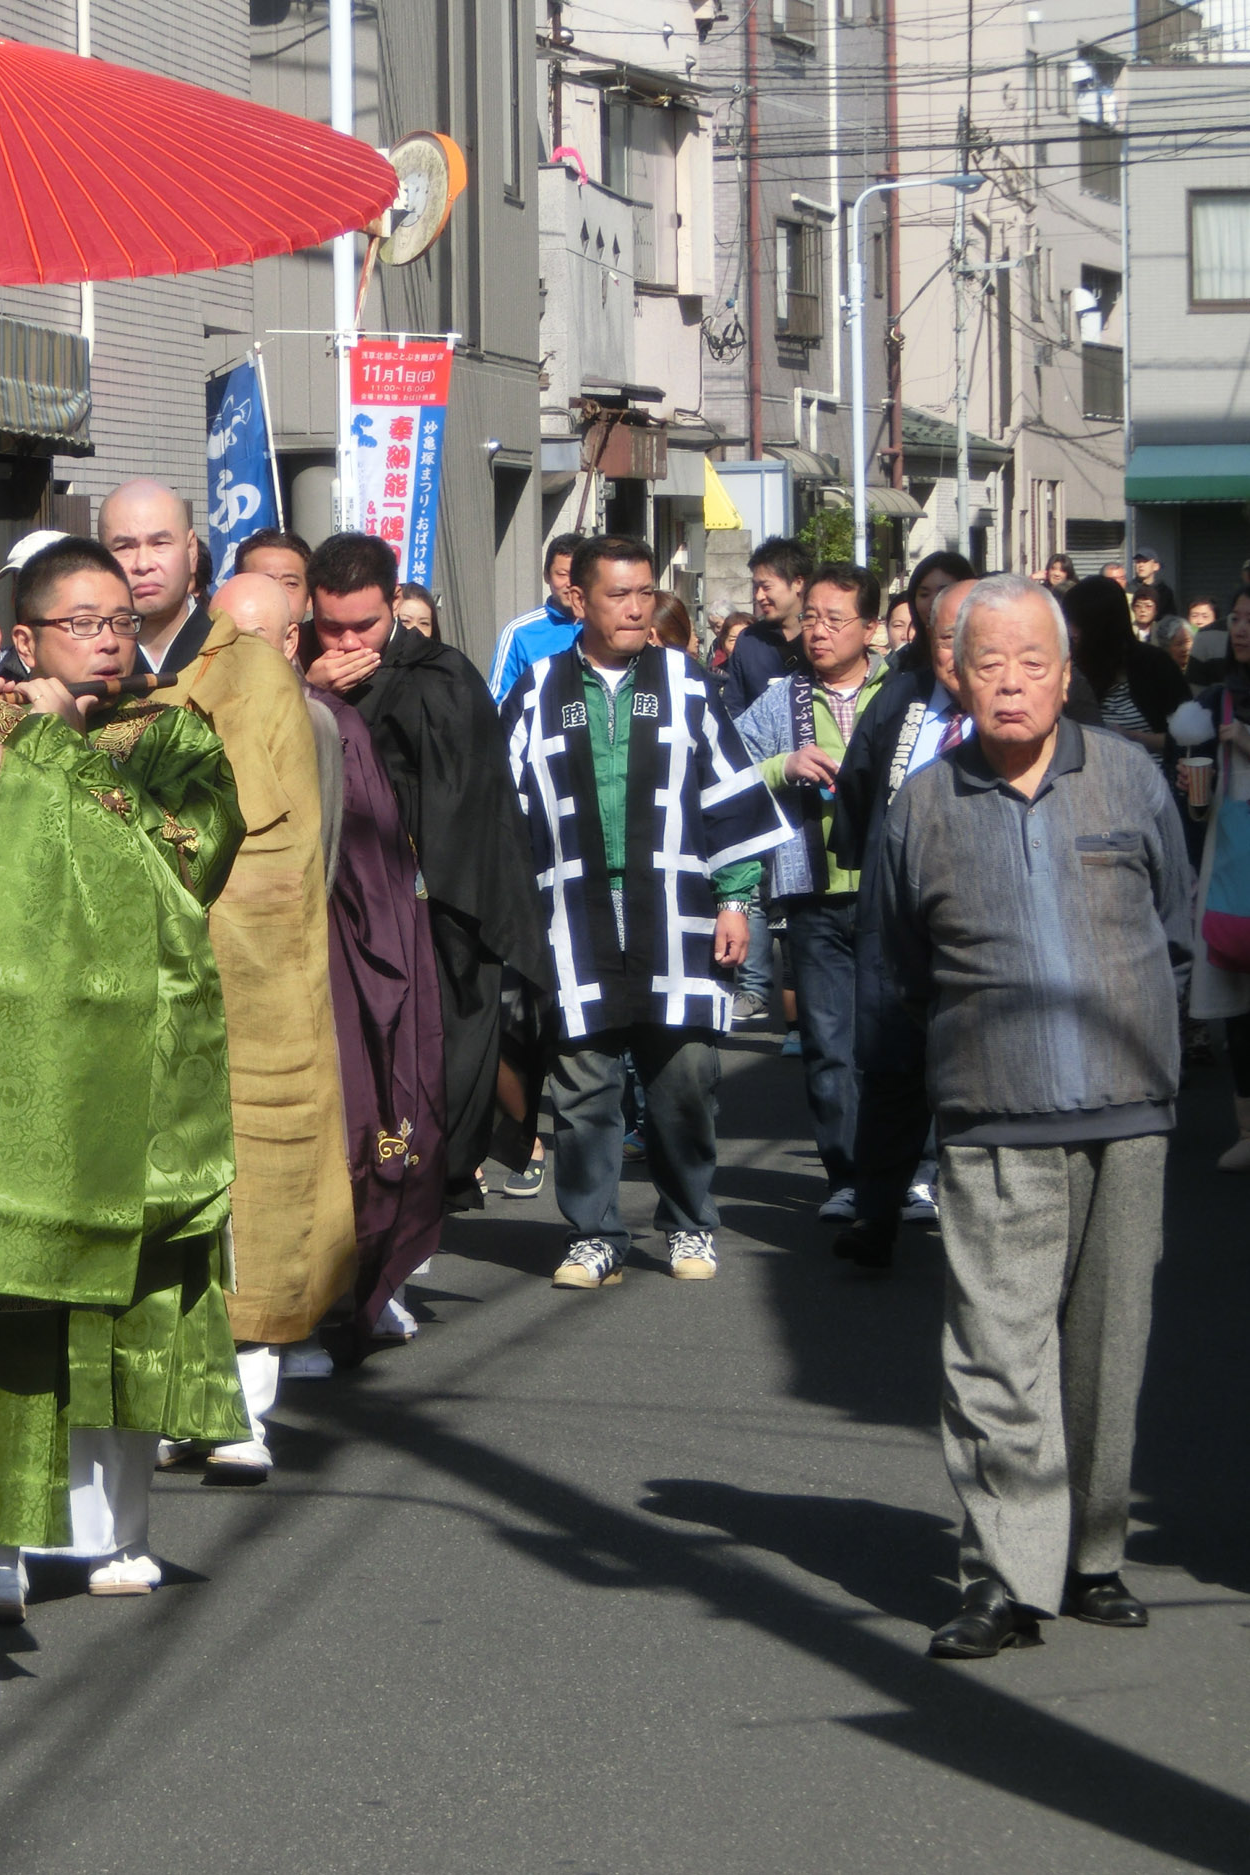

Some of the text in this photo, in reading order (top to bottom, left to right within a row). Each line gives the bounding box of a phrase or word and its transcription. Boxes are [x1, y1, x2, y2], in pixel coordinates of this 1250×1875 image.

[362, 364, 436, 383] 11月1日(日)
[561, 701, 587, 729] 睦
[632, 692, 659, 718] 睦
